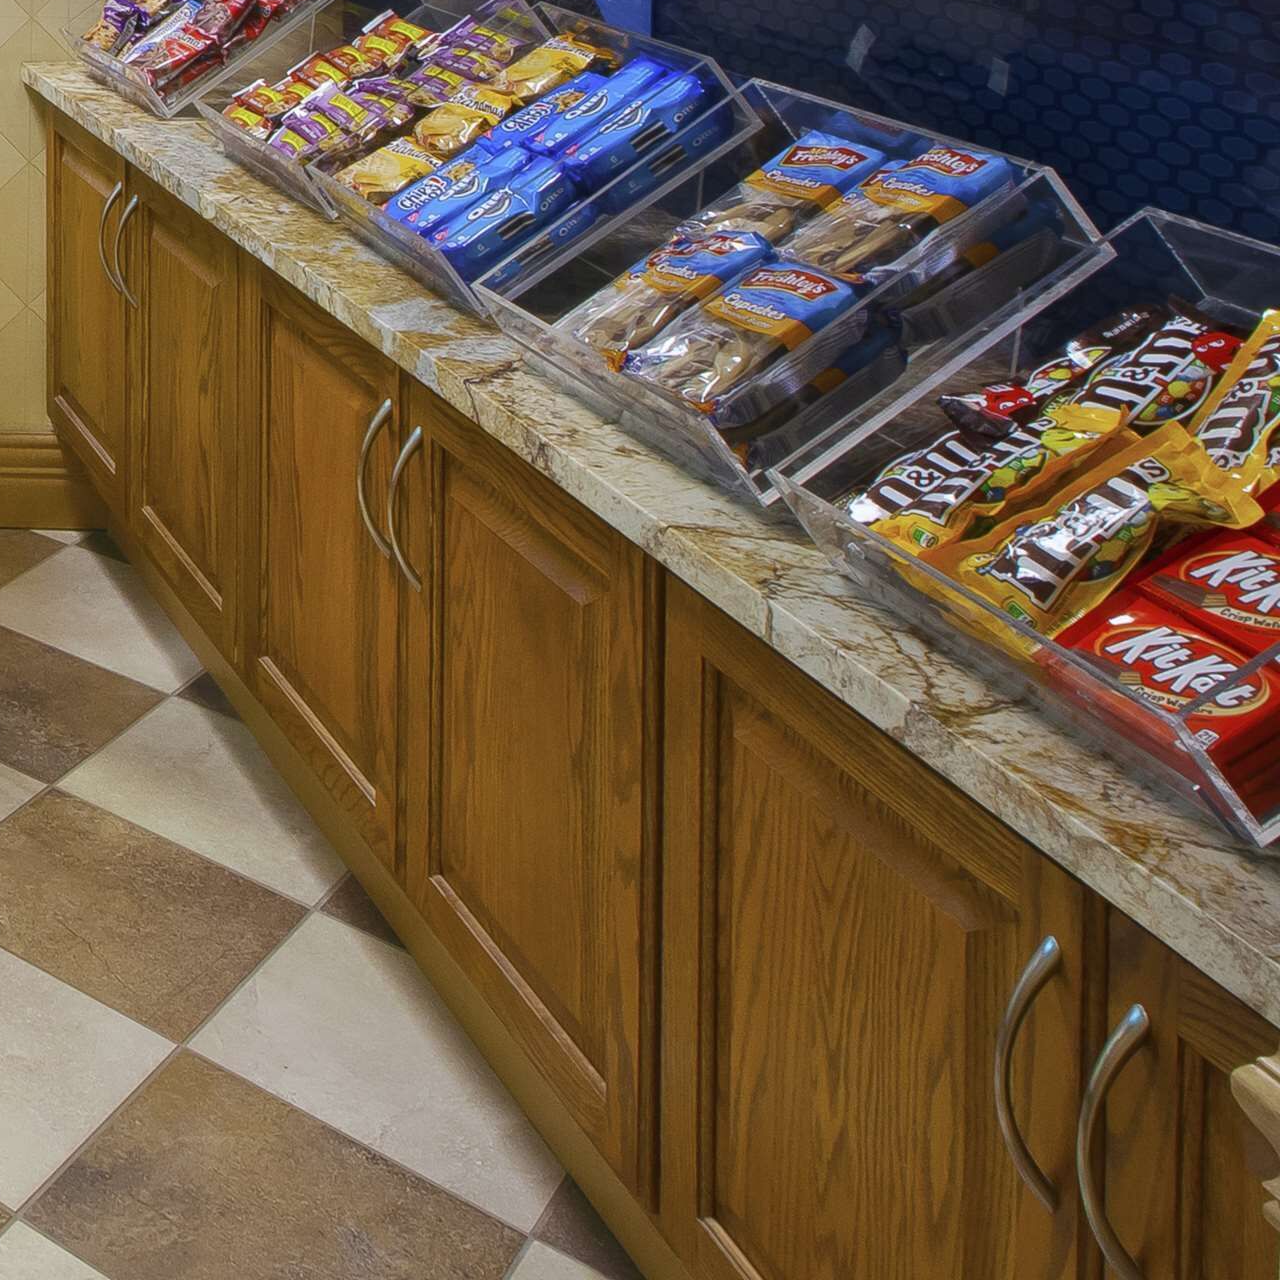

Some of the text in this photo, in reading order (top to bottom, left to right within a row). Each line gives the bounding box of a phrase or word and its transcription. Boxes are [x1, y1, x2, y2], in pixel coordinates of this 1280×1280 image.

[791, 148, 860, 166] Freshley's
[766, 170, 822, 188] Cupcakes
[883, 177, 935, 196] Cupcakes
[751, 270, 827, 295] Freshley's
[725, 293, 786, 320] Cupcakes
[1220, 608, 1251, 626] Crisp
